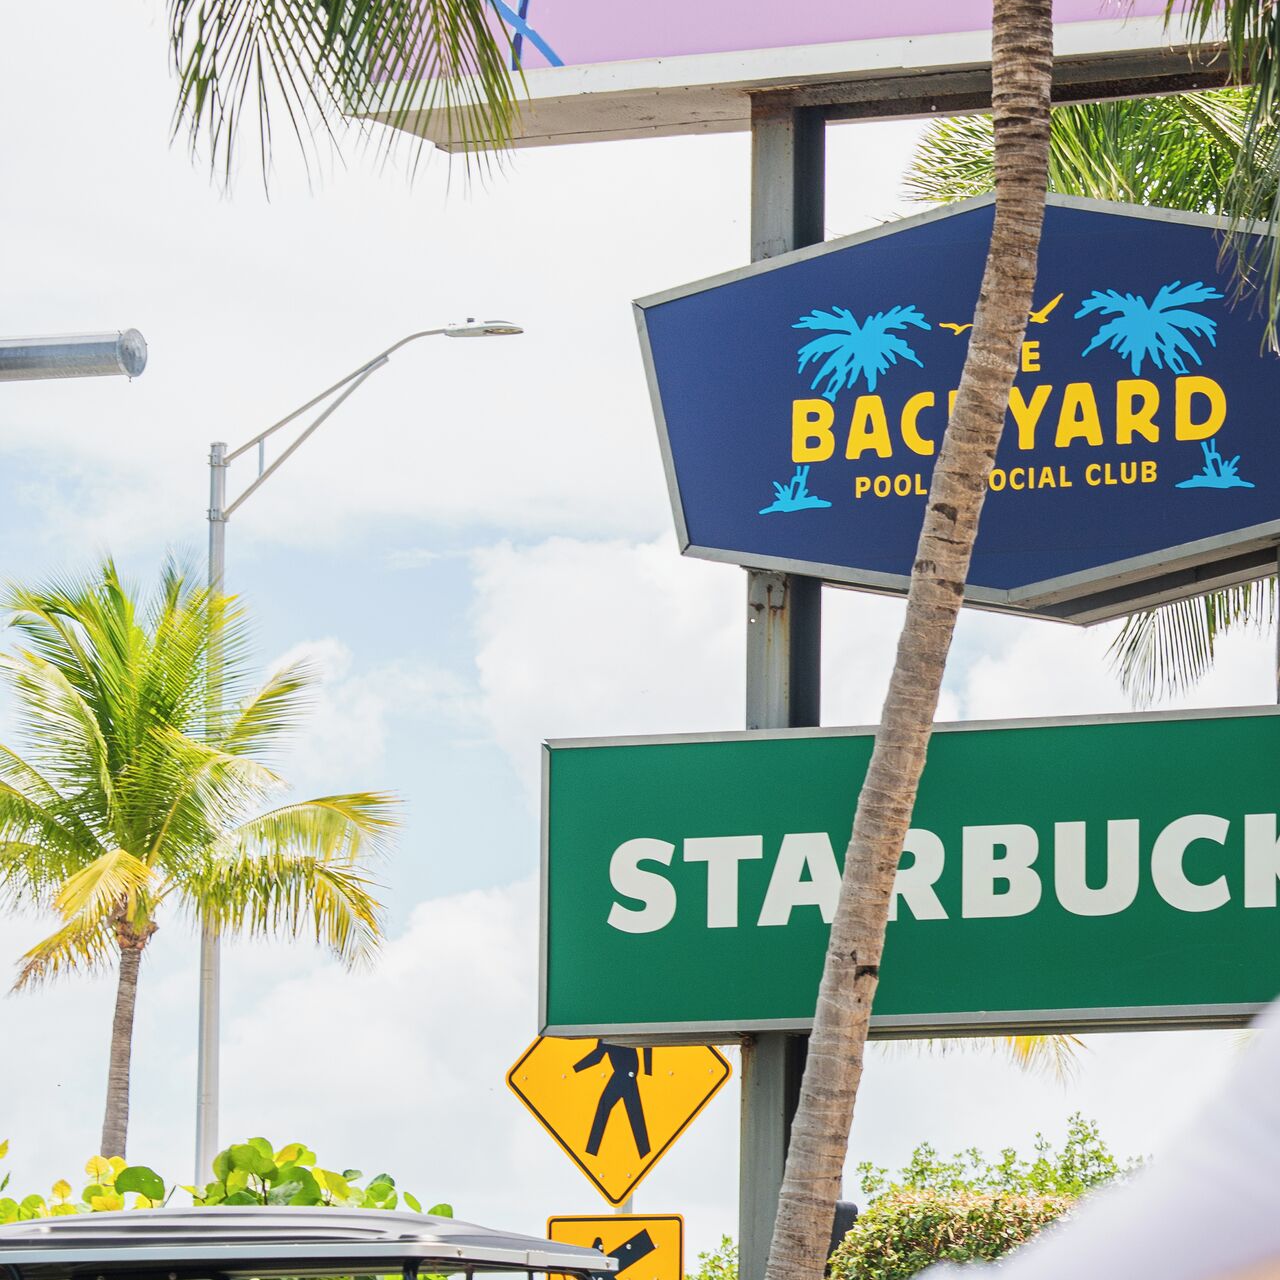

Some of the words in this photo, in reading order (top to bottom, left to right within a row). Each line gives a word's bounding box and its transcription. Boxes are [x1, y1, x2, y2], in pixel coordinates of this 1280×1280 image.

[790, 375, 1228, 463] BACYARD
[854, 473, 928, 498] POOL
[988, 465, 1074, 491] OCIAL
[1085, 460, 1158, 486] CLUB
